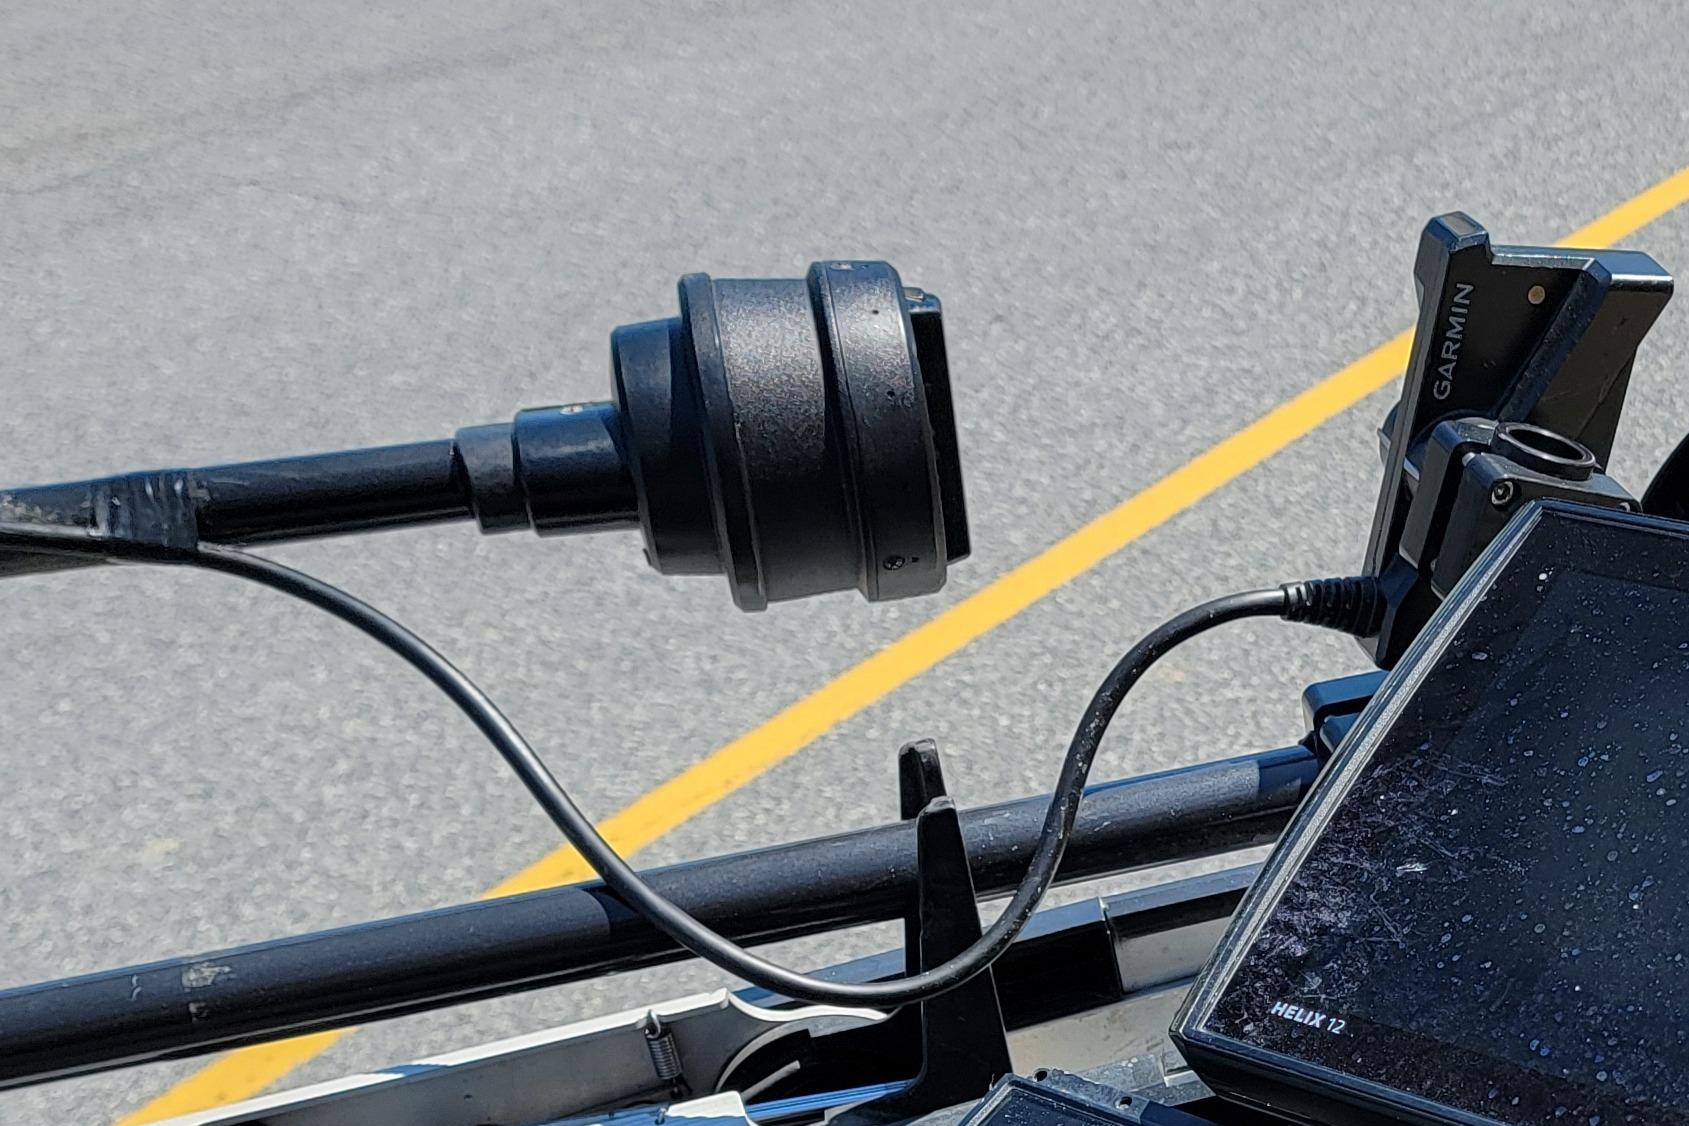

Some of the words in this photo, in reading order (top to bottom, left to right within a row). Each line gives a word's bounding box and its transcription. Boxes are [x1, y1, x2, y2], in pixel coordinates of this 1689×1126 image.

[1433, 281, 1475, 401] GARMIN
[1271, 1001, 1327, 1028] HELIX
[1327, 1017, 1346, 1035] 12
